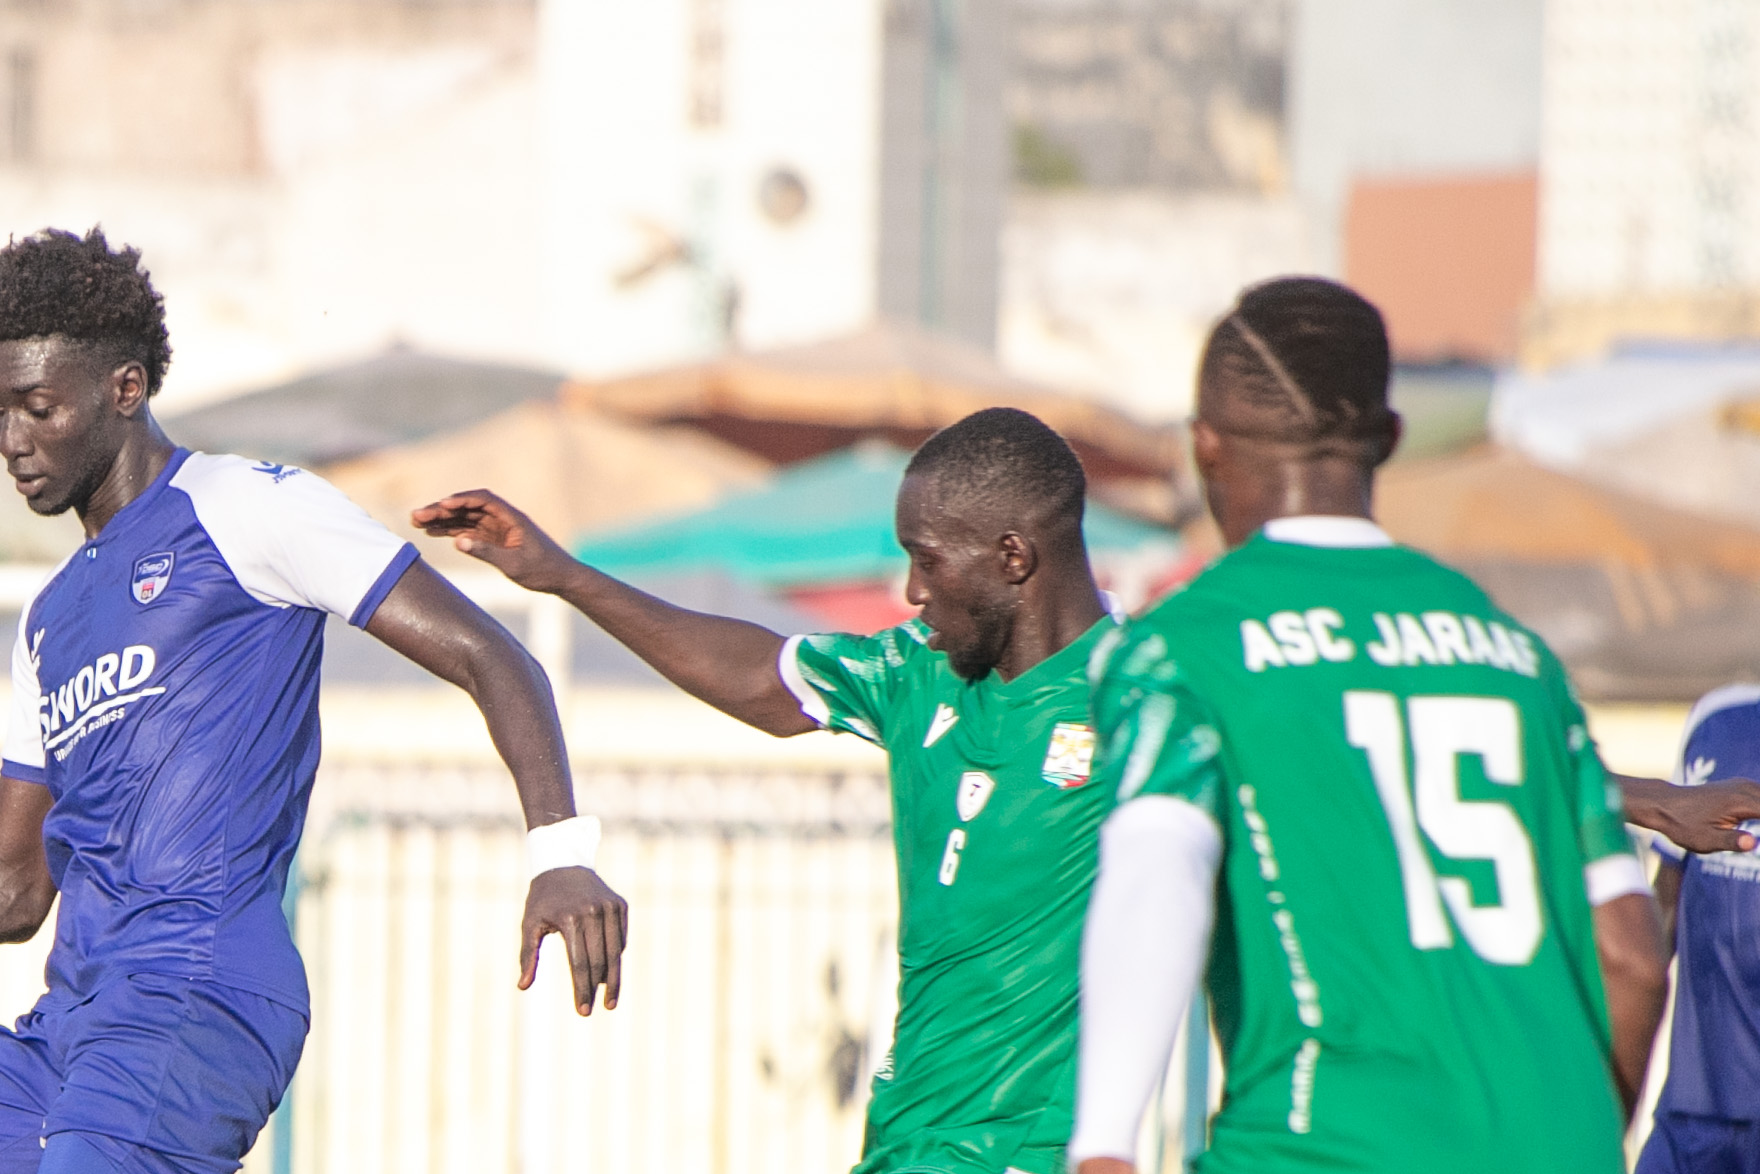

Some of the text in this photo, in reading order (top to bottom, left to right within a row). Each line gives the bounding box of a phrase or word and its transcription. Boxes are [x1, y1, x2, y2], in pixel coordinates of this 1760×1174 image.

[1240, 607, 1354, 673] ASC
[40, 645, 156, 744] SWORD
[938, 828, 966, 886] 6
[1342, 689, 1543, 967] 15
